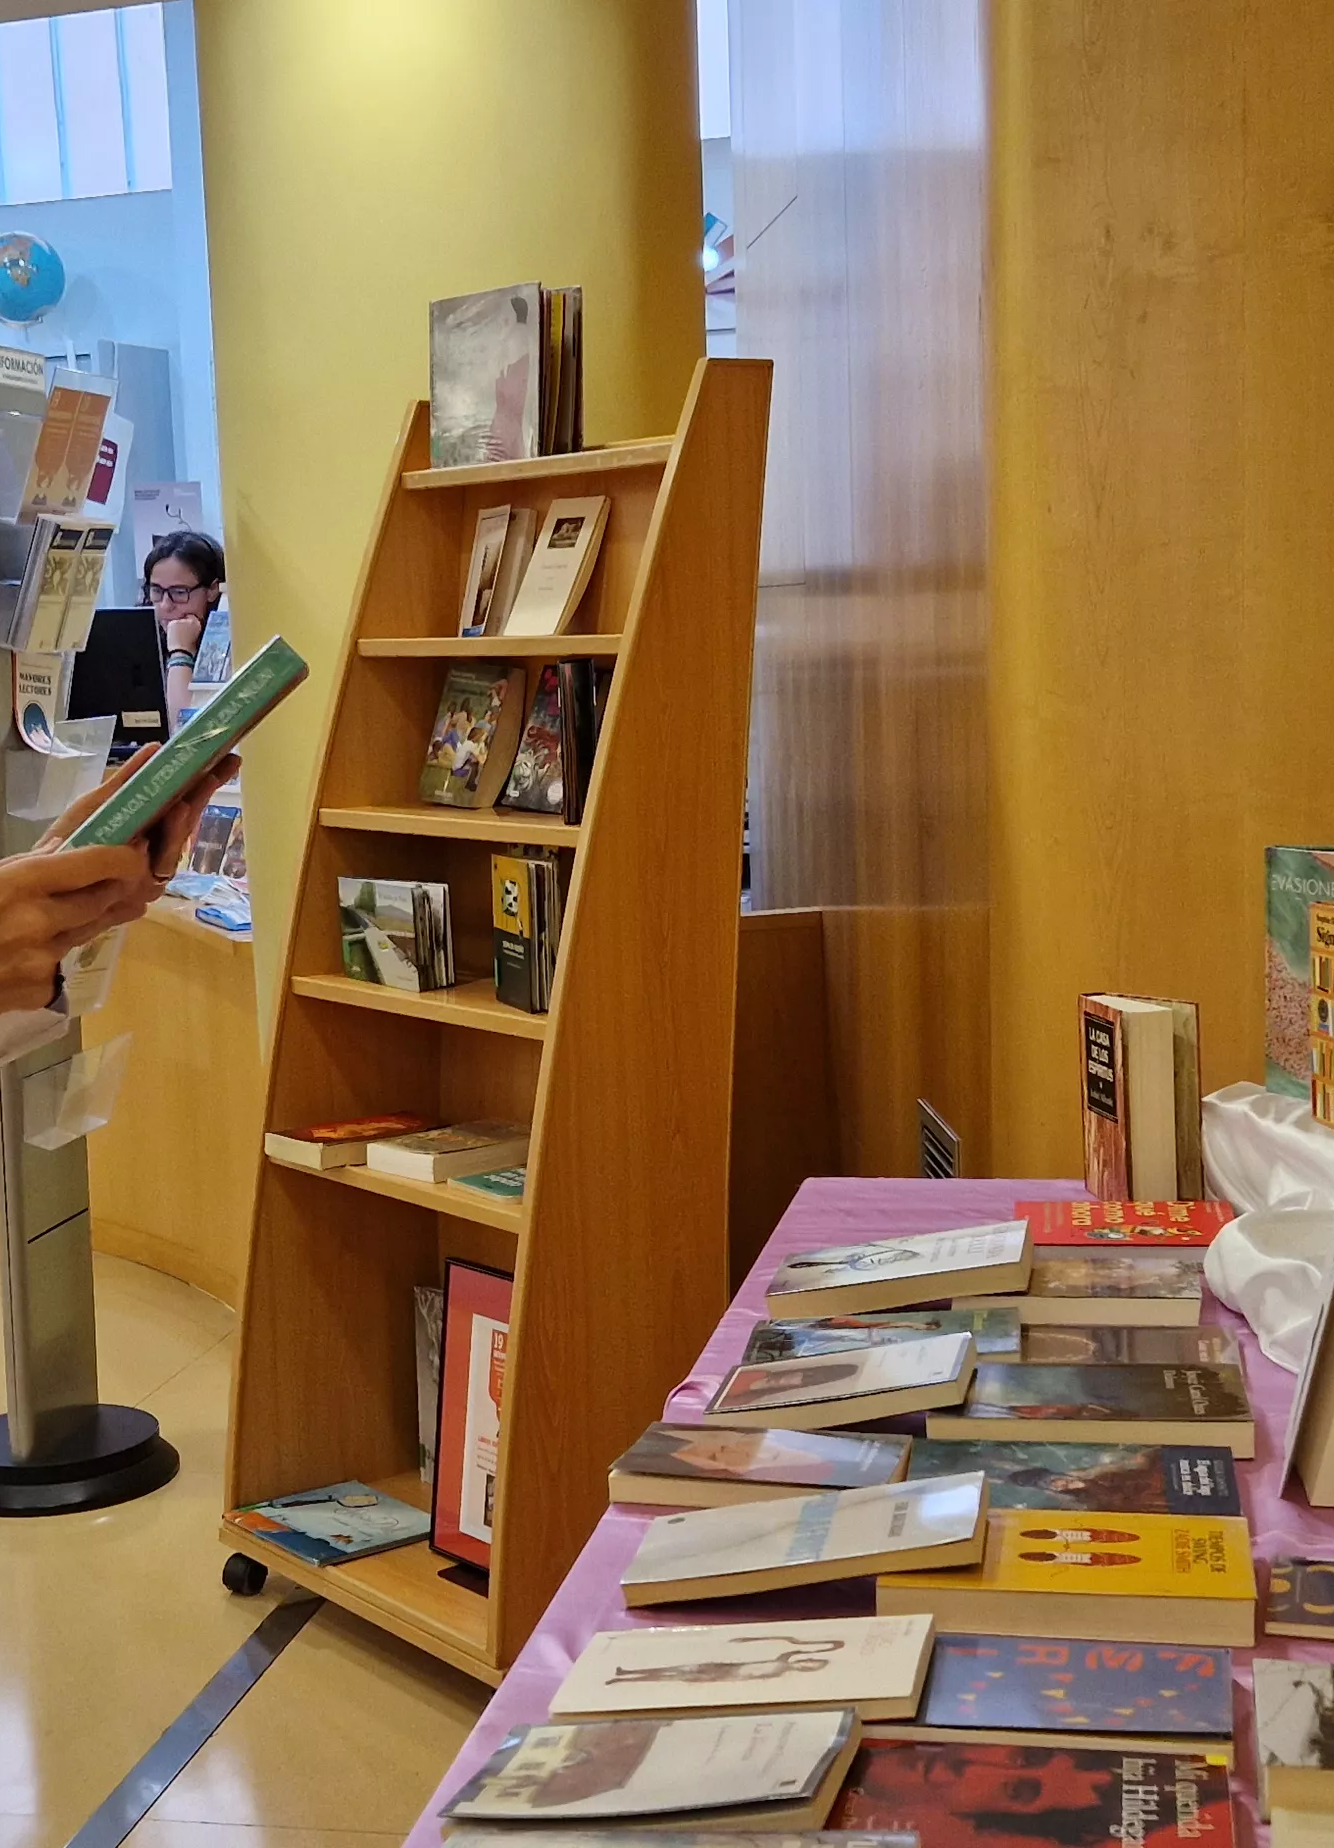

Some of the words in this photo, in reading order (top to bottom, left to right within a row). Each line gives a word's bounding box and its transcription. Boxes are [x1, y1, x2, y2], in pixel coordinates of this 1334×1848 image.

[18, 684, 52, 697] LECTORES
[493, 1332, 504, 1349] 19
[1208, 1530, 1226, 1562] TIEMPOS
[1210, 1563, 1227, 1574] DE
[1175, 1759, 1210, 1781] Mi
[1164, 1781, 1216, 1838] querida
